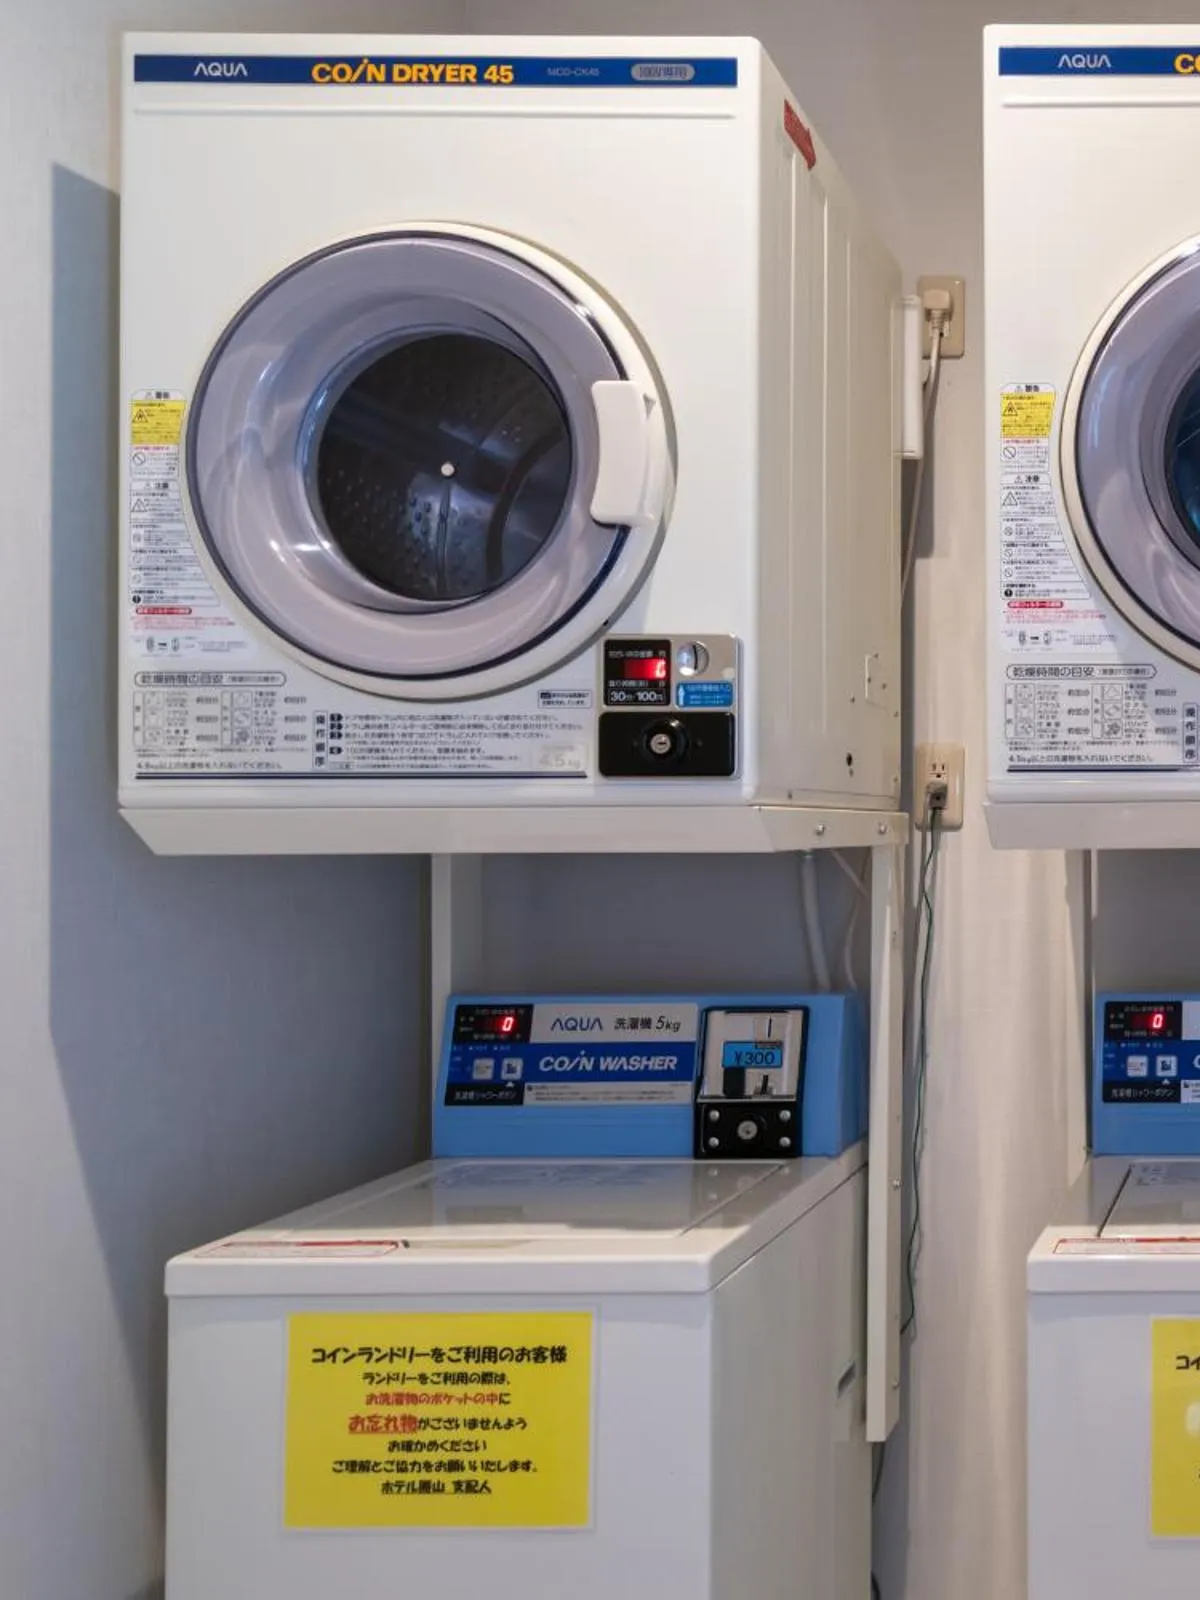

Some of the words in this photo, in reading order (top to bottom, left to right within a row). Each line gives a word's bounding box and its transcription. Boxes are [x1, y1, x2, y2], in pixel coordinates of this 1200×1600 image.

[1057, 54, 1112, 69] AQUA
[193, 62, 248, 77] AQUA
[311, 58, 387, 83] COIN
[392, 63, 478, 83] DRYER
[483, 64, 515, 83] 45
[502, 1017, 514, 1032] 0
[551, 1016, 603, 1031] AQUA
[614, 1017, 652, 1030] 洗濯機
[656, 1015, 681, 1032] 5kg
[1152, 1014, 1163, 1029] 0
[539, 1050, 595, 1071] COIN
[600, 1056, 678, 1071] WASHER
[312, 1346, 567, 1364] コインランドリーをご利用のお客様
[365, 1391, 511, 1406] お洗濯物のポケットの中に
[348, 1414, 528, 1434] お忘れ物がございませんよう
[388, 1439, 488, 1453] お確かめください
[332, 1459, 538, 1474] ご理解とご協力をお願いいたします。
[452, 1480, 492, 1494] 支配人
